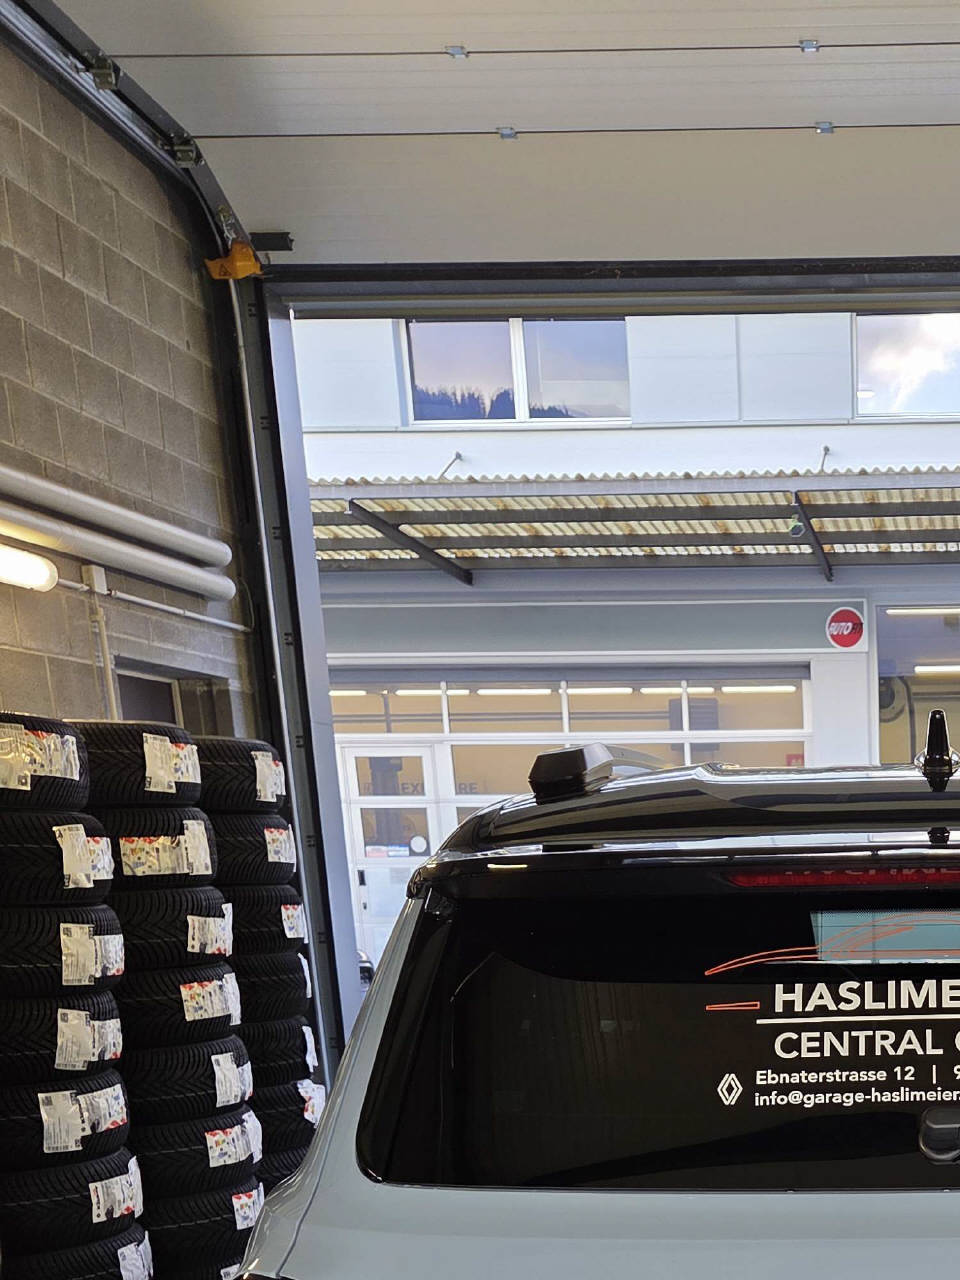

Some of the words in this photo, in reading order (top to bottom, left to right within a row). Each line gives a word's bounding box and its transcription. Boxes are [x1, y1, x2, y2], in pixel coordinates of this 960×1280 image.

[774, 1028, 944, 1059] CENTRAL
[755, 1069, 888, 1085] Ebnaterstrasse
[893, 1065, 915, 1081] 12
